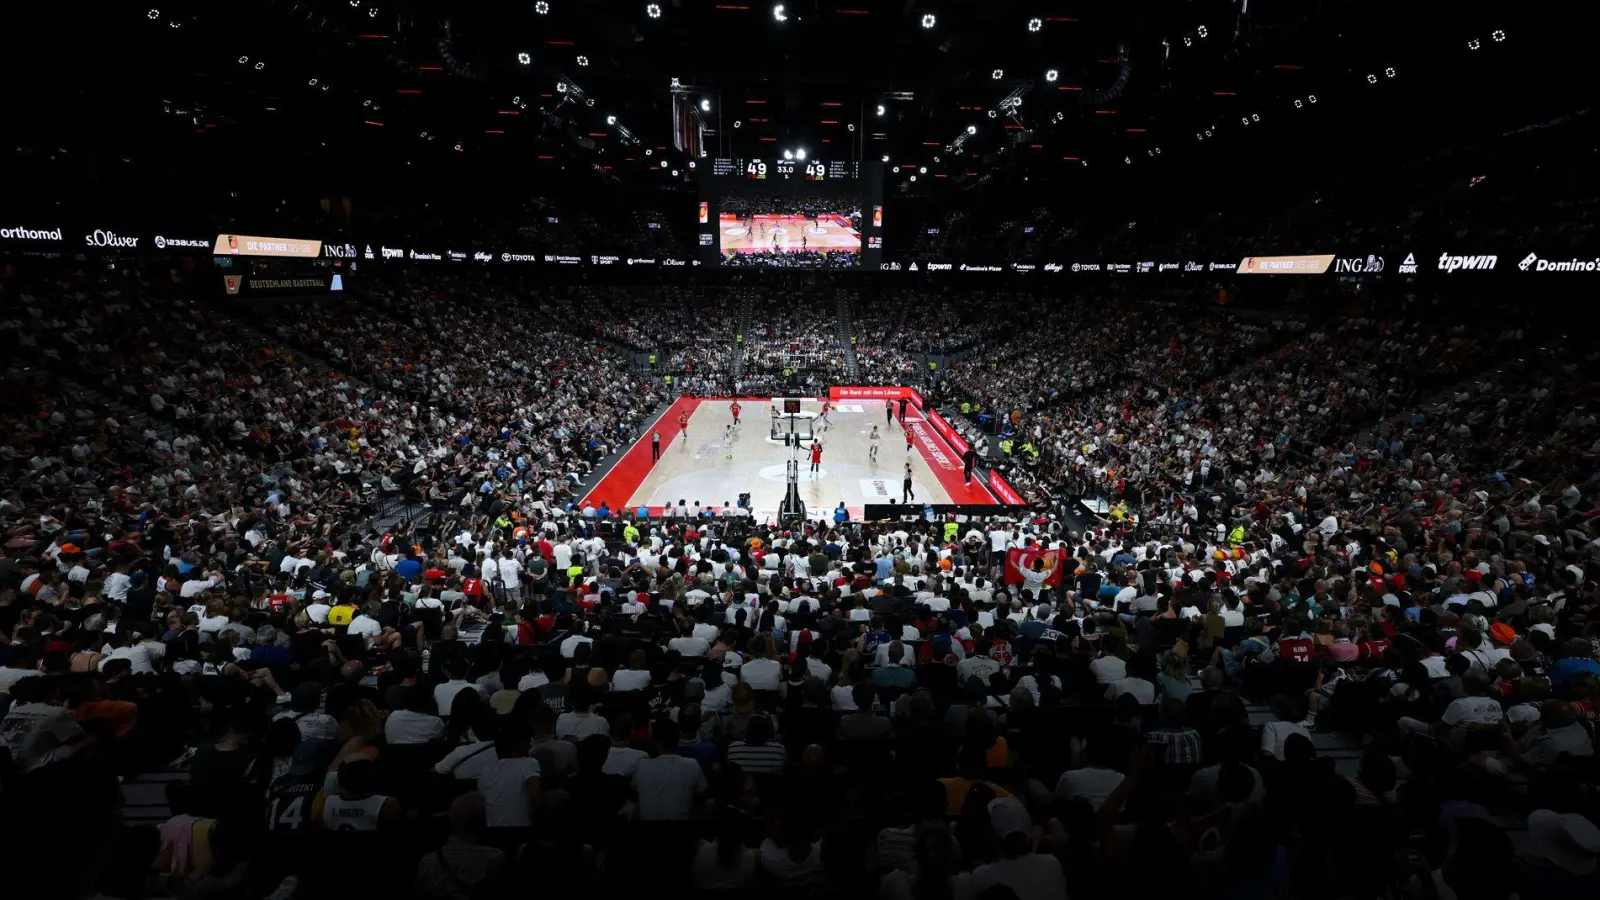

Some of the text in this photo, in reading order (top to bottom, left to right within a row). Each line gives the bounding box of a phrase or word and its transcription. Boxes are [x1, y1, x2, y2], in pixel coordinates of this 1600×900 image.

[748, 162, 766, 175] 49
[806, 165, 825, 176] 49
[1, 226, 62, 240] orthomol
[86, 230, 138, 247] s.Oliver
[247, 241, 258, 250] DIE
[259, 242, 287, 252] PARTNER
[325, 245, 343, 257] ING
[512, 254, 536, 262] TOYOTA
[1438, 252, 1497, 273] tipwin
[928, 263, 952, 271] tipwin
[1269, 261, 1294, 270] PARTNER
[1335, 258, 1363, 273] ING
[1399, 265, 1418, 273] PEAK
[250, 279, 325, 289] DEUTSCHLAND BASKETBALL
[269, 796, 306, 832] 14
